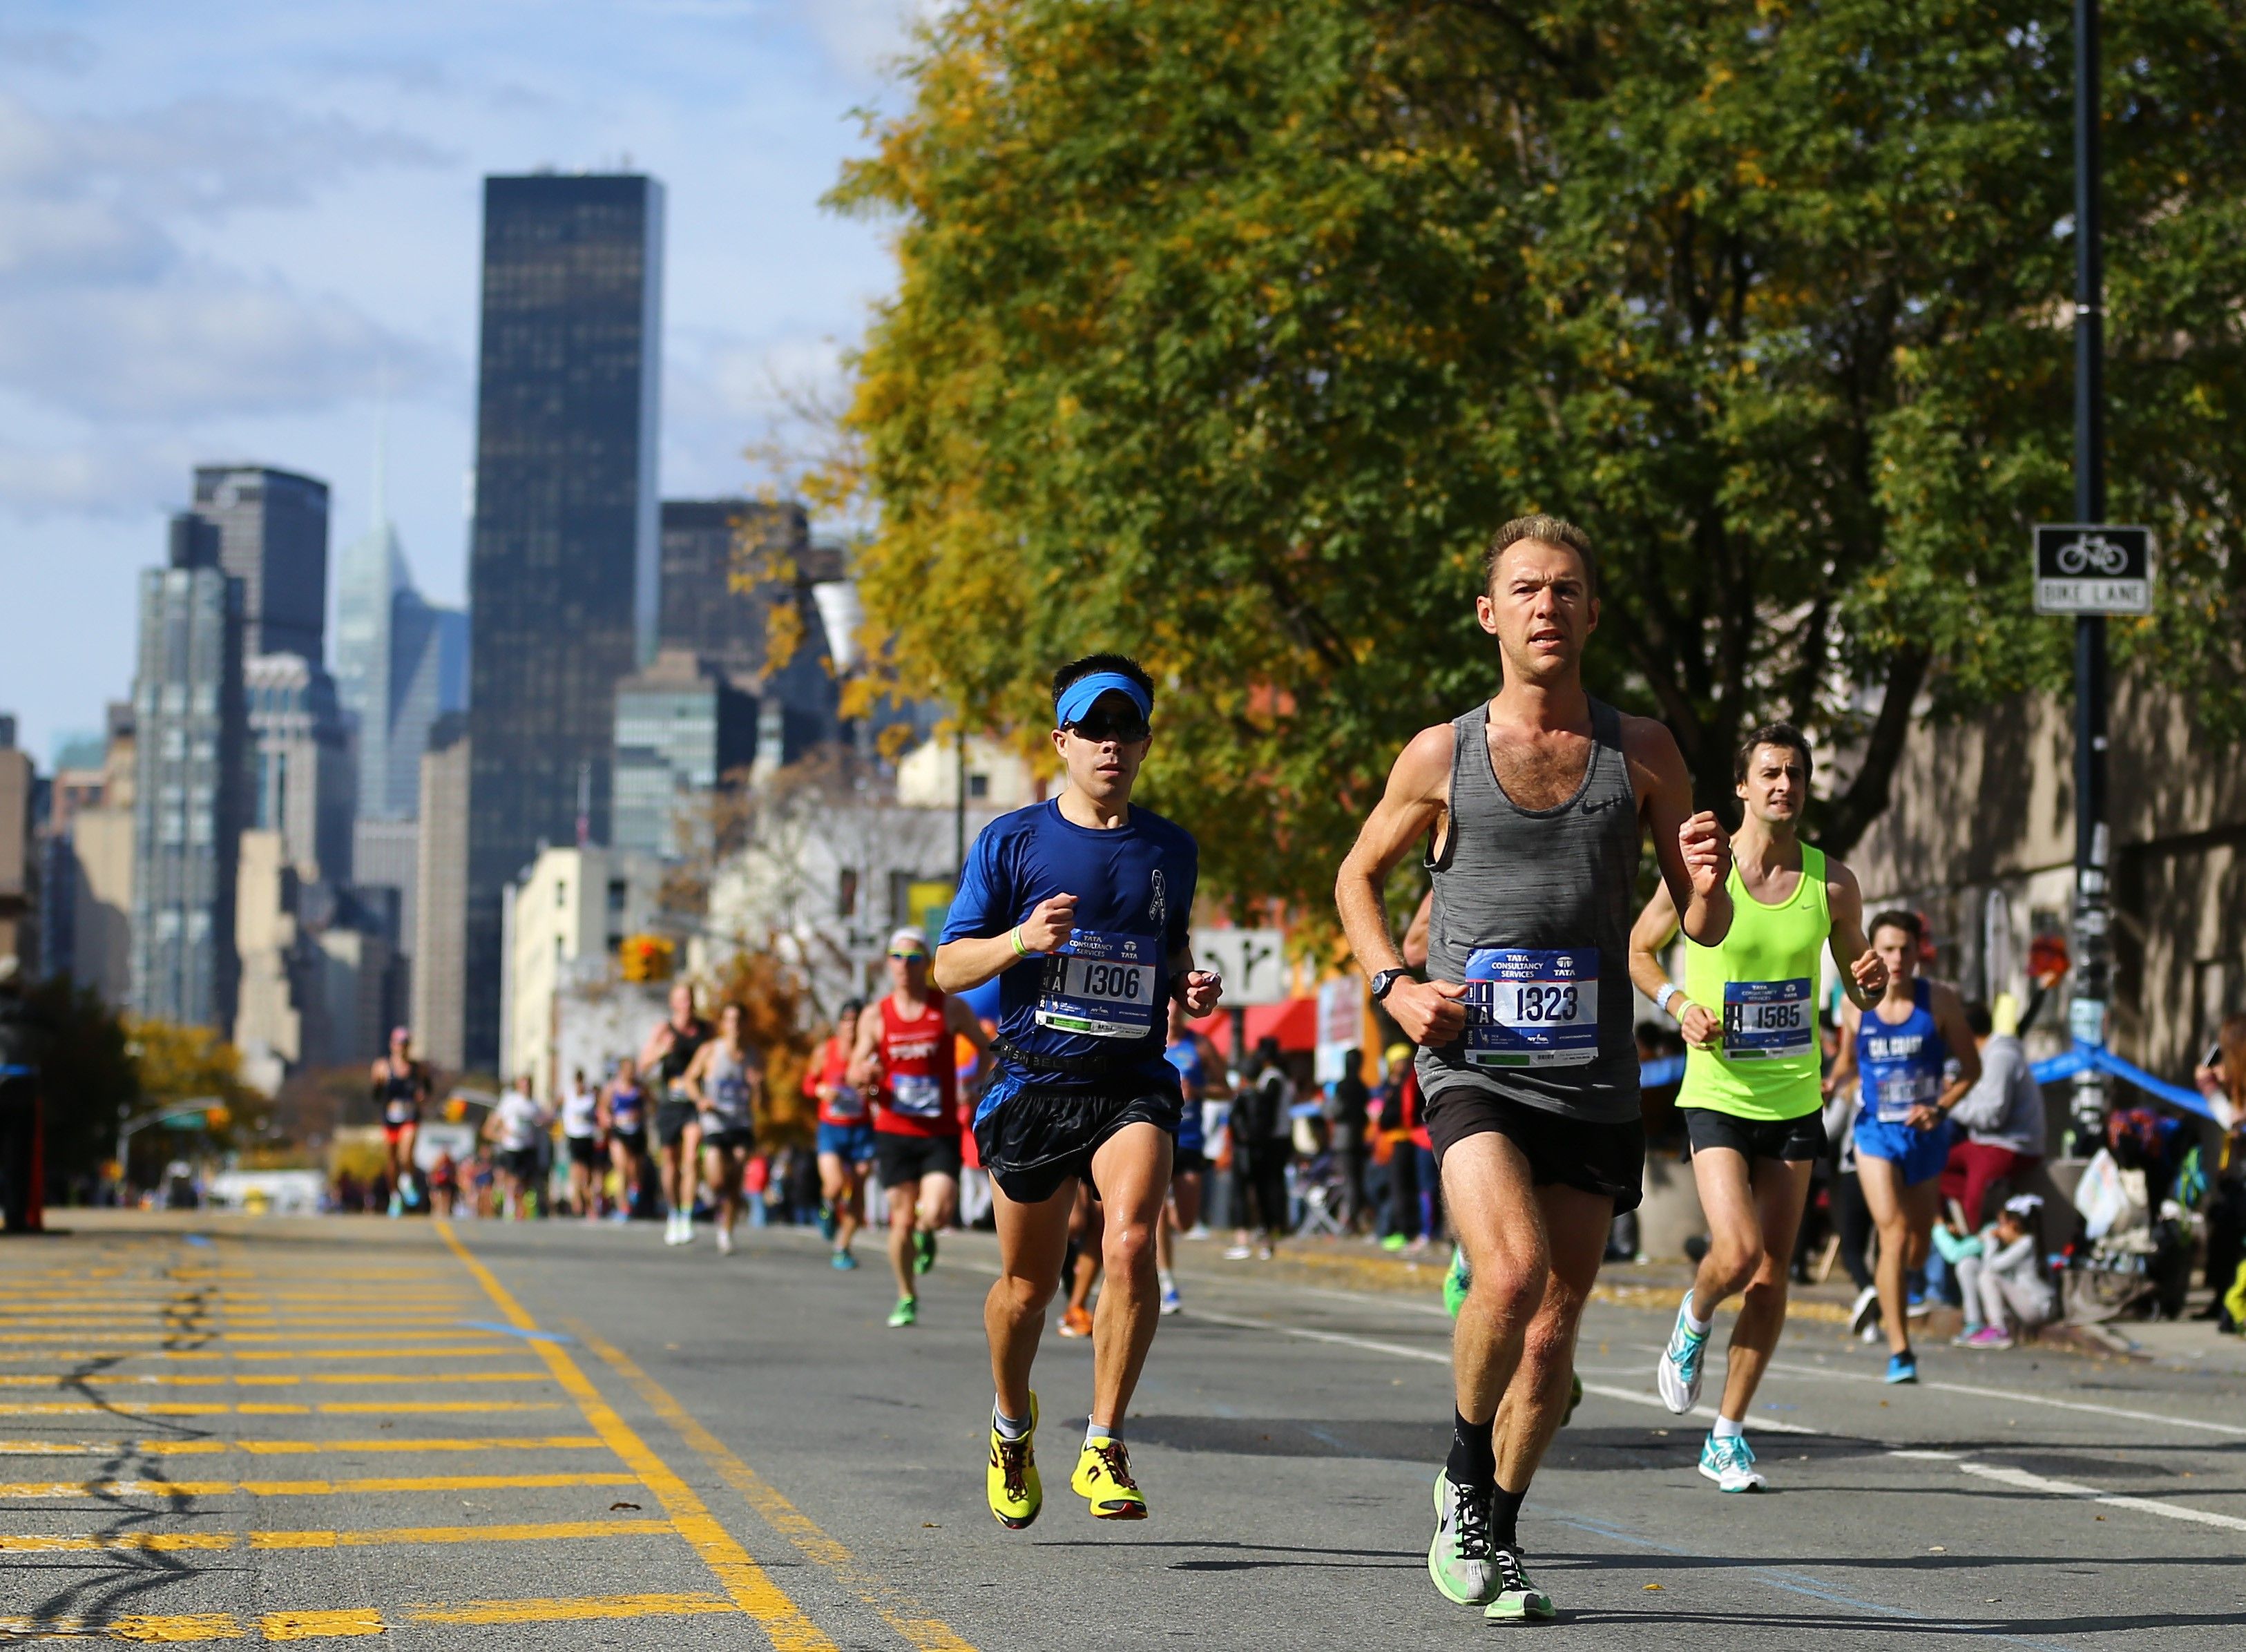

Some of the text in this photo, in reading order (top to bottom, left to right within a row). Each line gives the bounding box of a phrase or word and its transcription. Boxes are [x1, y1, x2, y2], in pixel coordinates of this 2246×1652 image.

[2093, 585, 2139, 603] LANE
[1069, 940, 1113, 952] CONSULTANCY
[1077, 948, 1105, 957] SERVICES
[1491, 962, 1544, 970] CONSULTANCY
[1084, 964, 1140, 999] 1306
[1501, 970, 1535, 979] SERVICES
[1052, 976, 1062, 992] A
[1517, 986, 1578, 1021] 1323
[1479, 1006, 1490, 1024] A
[1758, 1004, 1801, 1029] 1585
[1732, 1019, 1740, 1032] A
